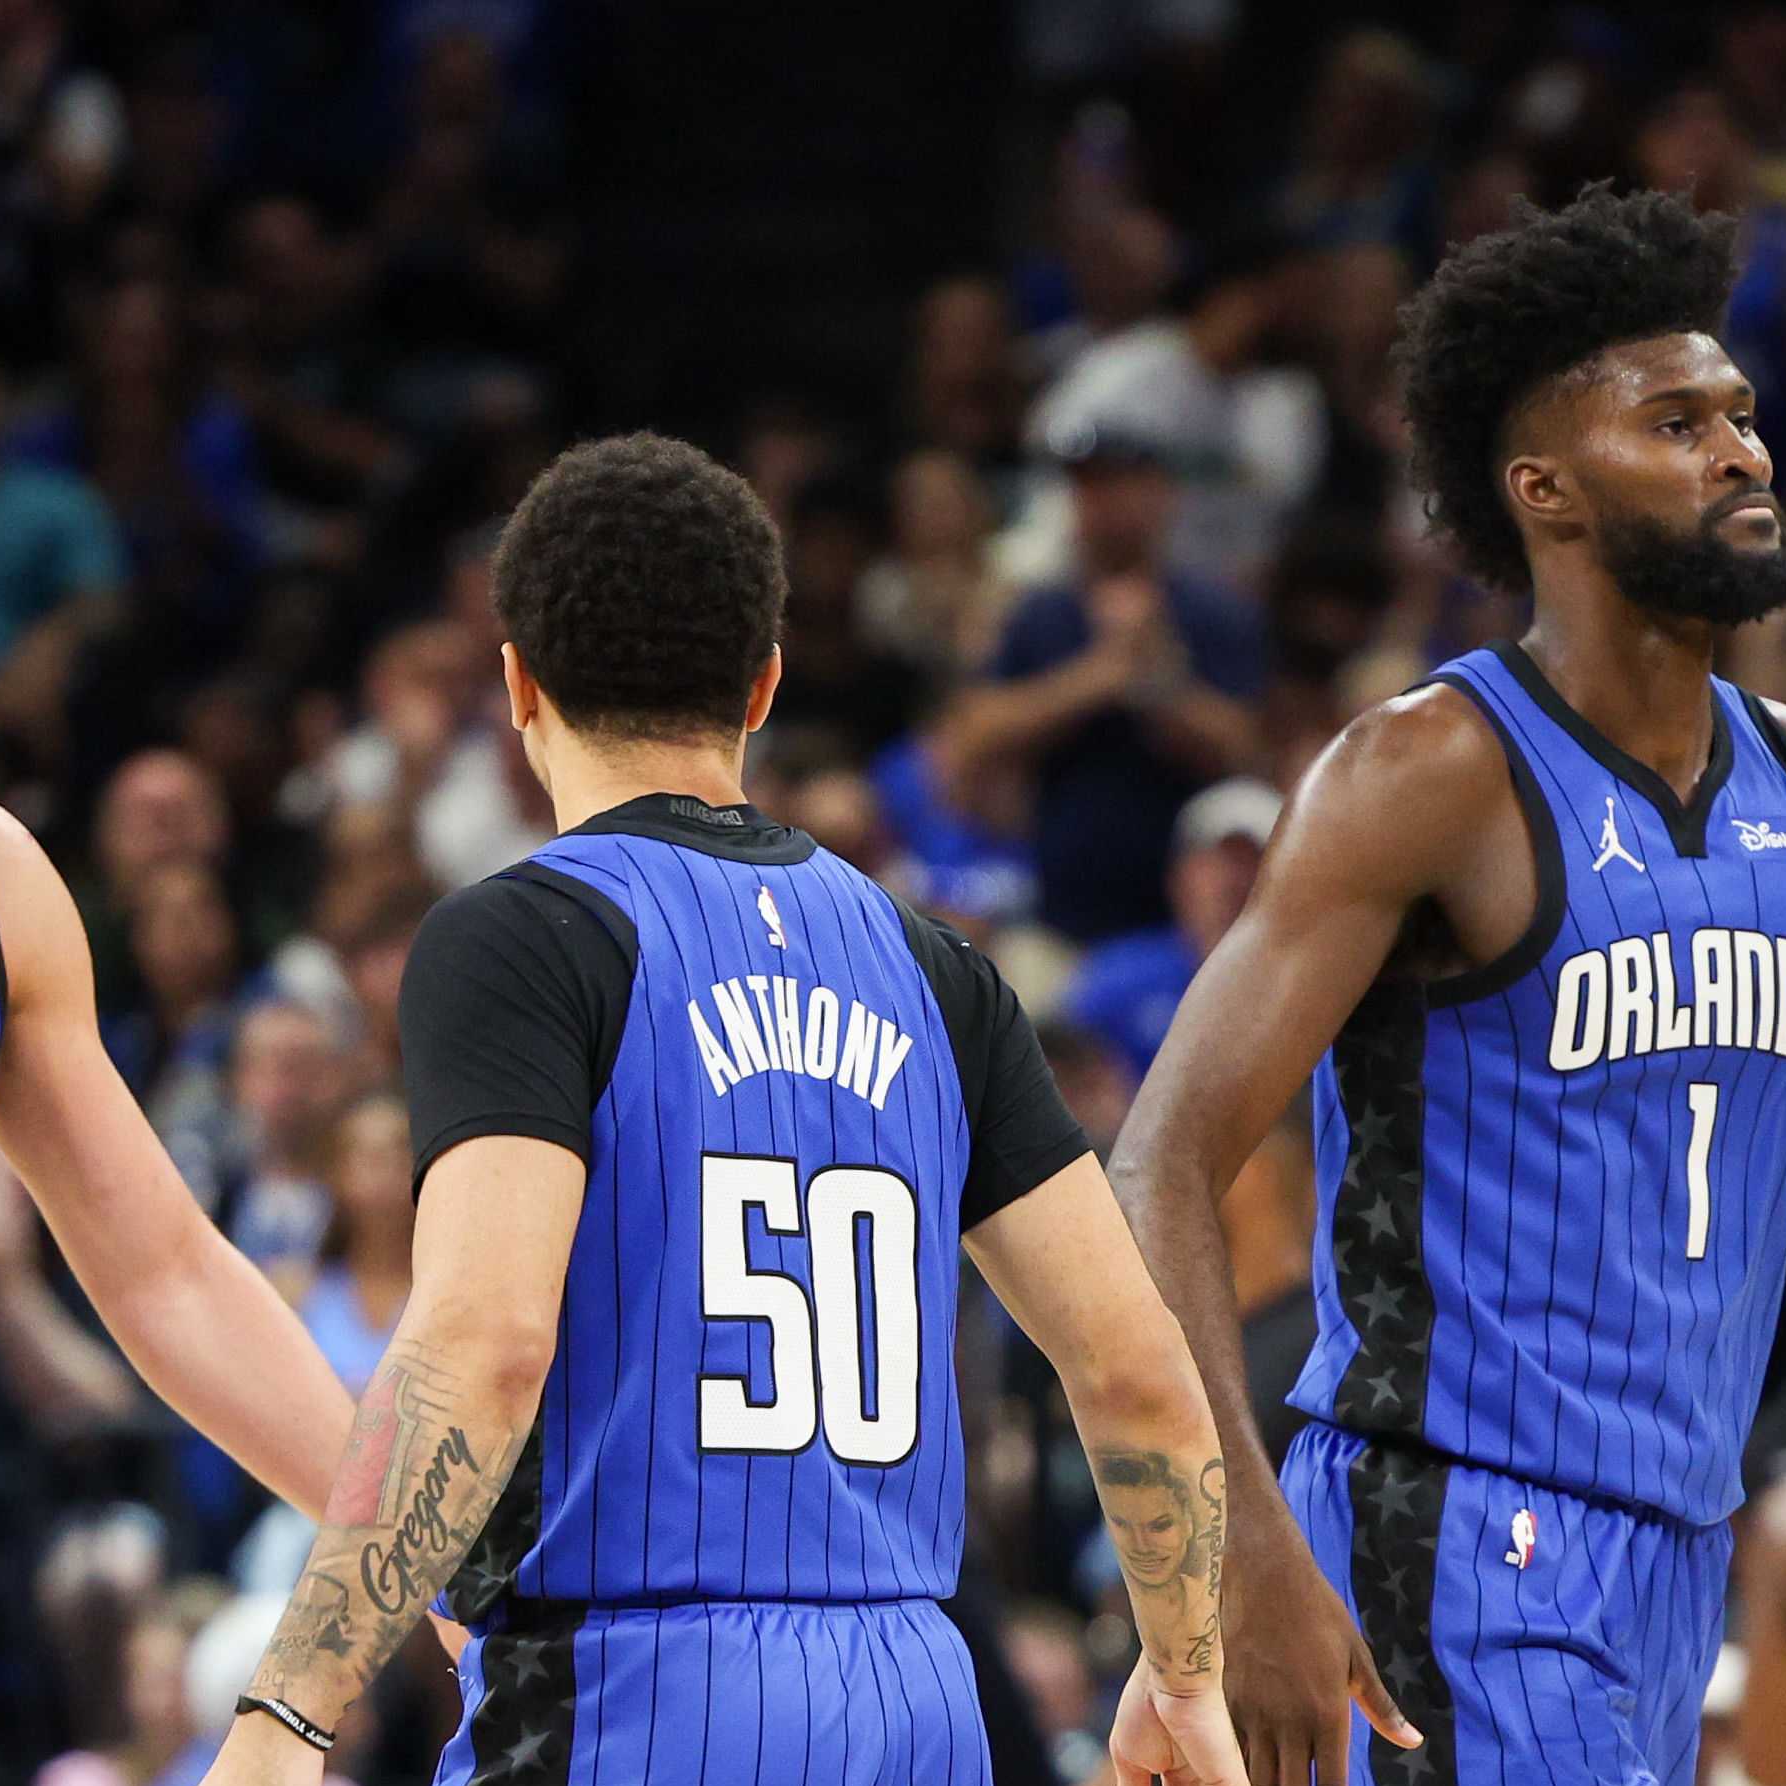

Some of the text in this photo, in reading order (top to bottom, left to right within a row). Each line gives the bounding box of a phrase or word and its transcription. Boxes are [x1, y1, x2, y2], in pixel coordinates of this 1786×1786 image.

[687, 974, 913, 1111] ANTHONY
[1685, 1082, 1718, 1261] 1
[697, 1150, 920, 1469] 50
[359, 1426, 480, 1615] Gregory
